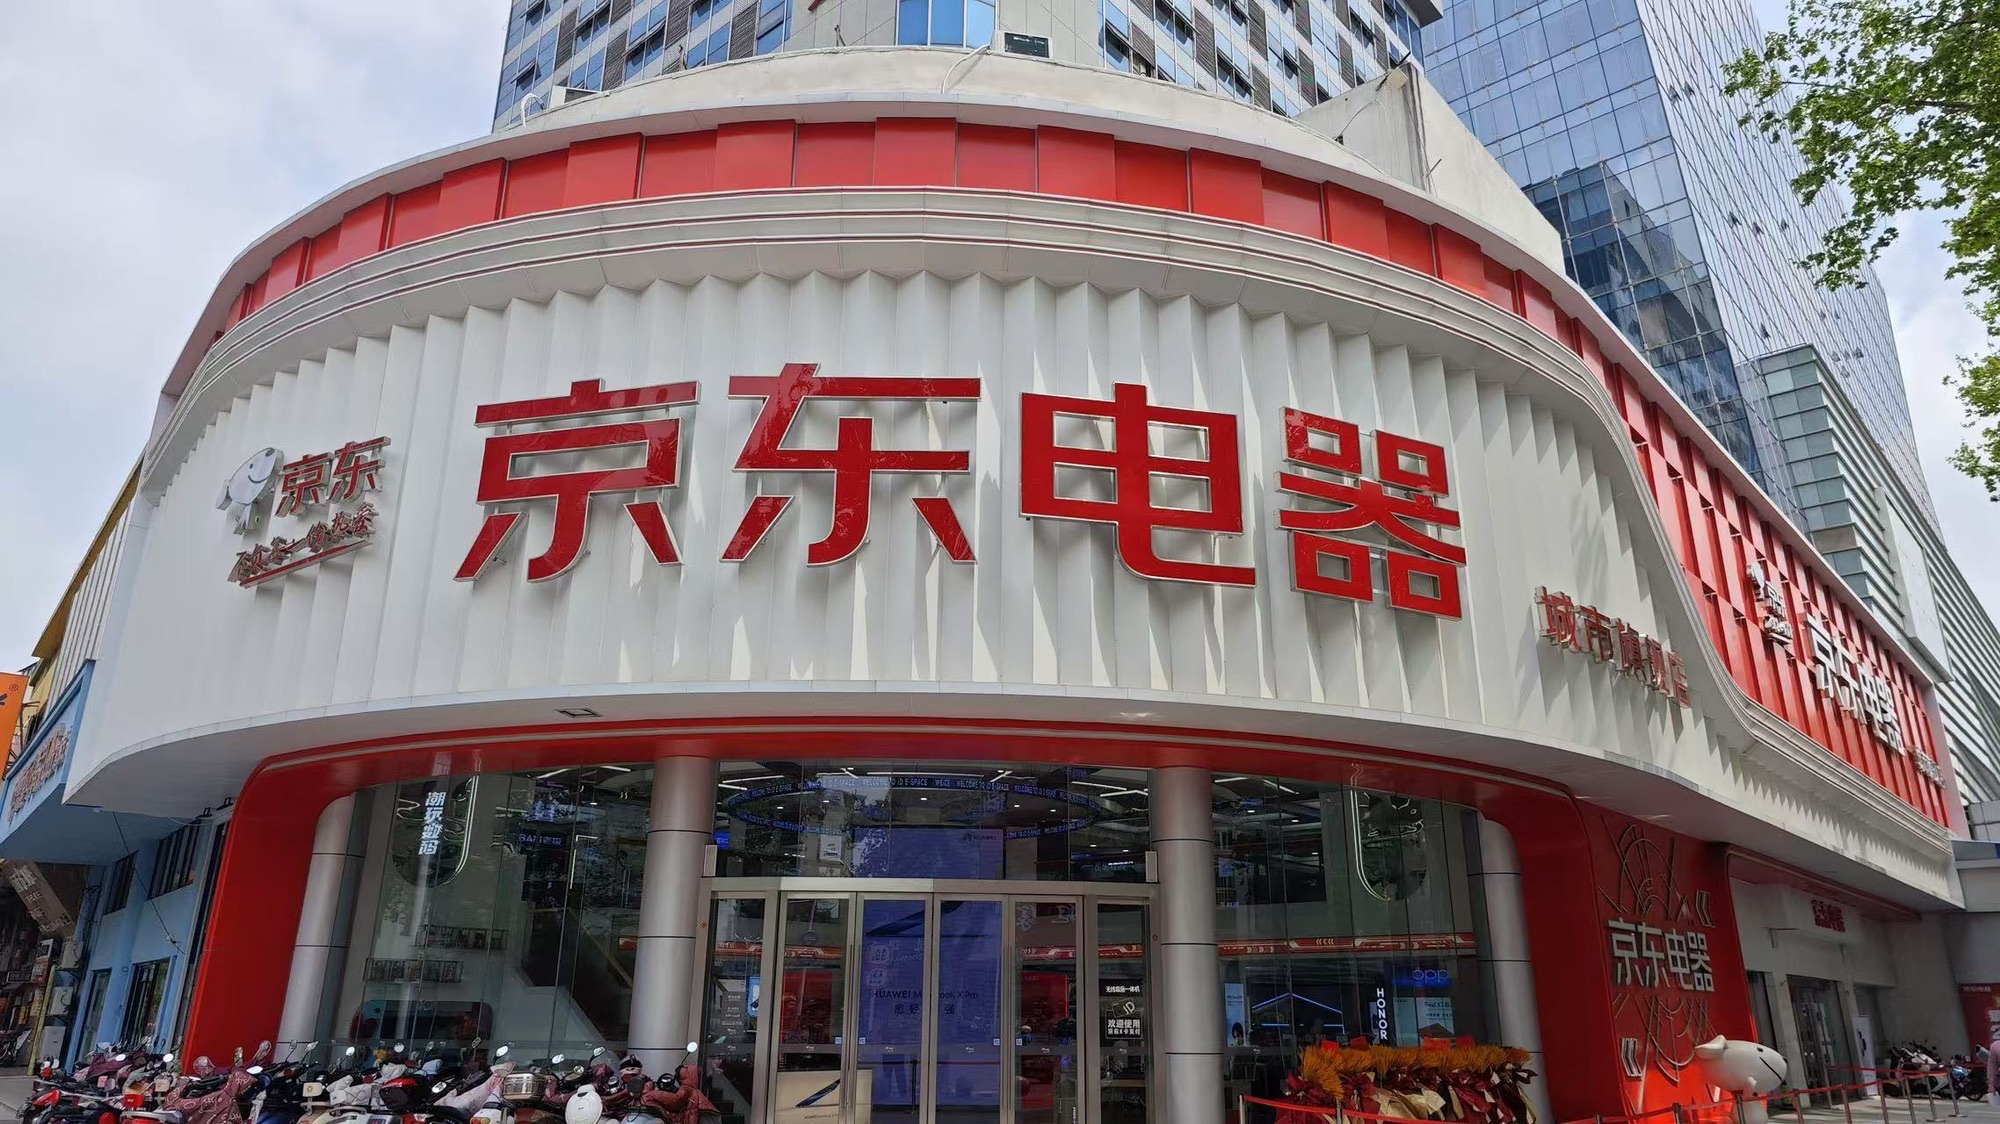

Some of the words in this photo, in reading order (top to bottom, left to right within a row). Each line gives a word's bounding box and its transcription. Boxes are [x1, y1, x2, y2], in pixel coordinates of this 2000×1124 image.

[275, 436, 391, 518] 京东
[454, 362, 1467, 622] 京东电器
[1534, 586, 1692, 709] 城市旗舰店
[1804, 611, 1906, 757] 京东电器
[418, 791, 447, 855] 潮玩数码
[1607, 917, 1715, 992] 京东电器
[872, 990, 911, 999] HUAWEI
[965, 990, 979, 999] Pro
[1107, 1018, 1141, 1029] 欢迎使用
[1376, 987, 1388, 1041] HONOR
